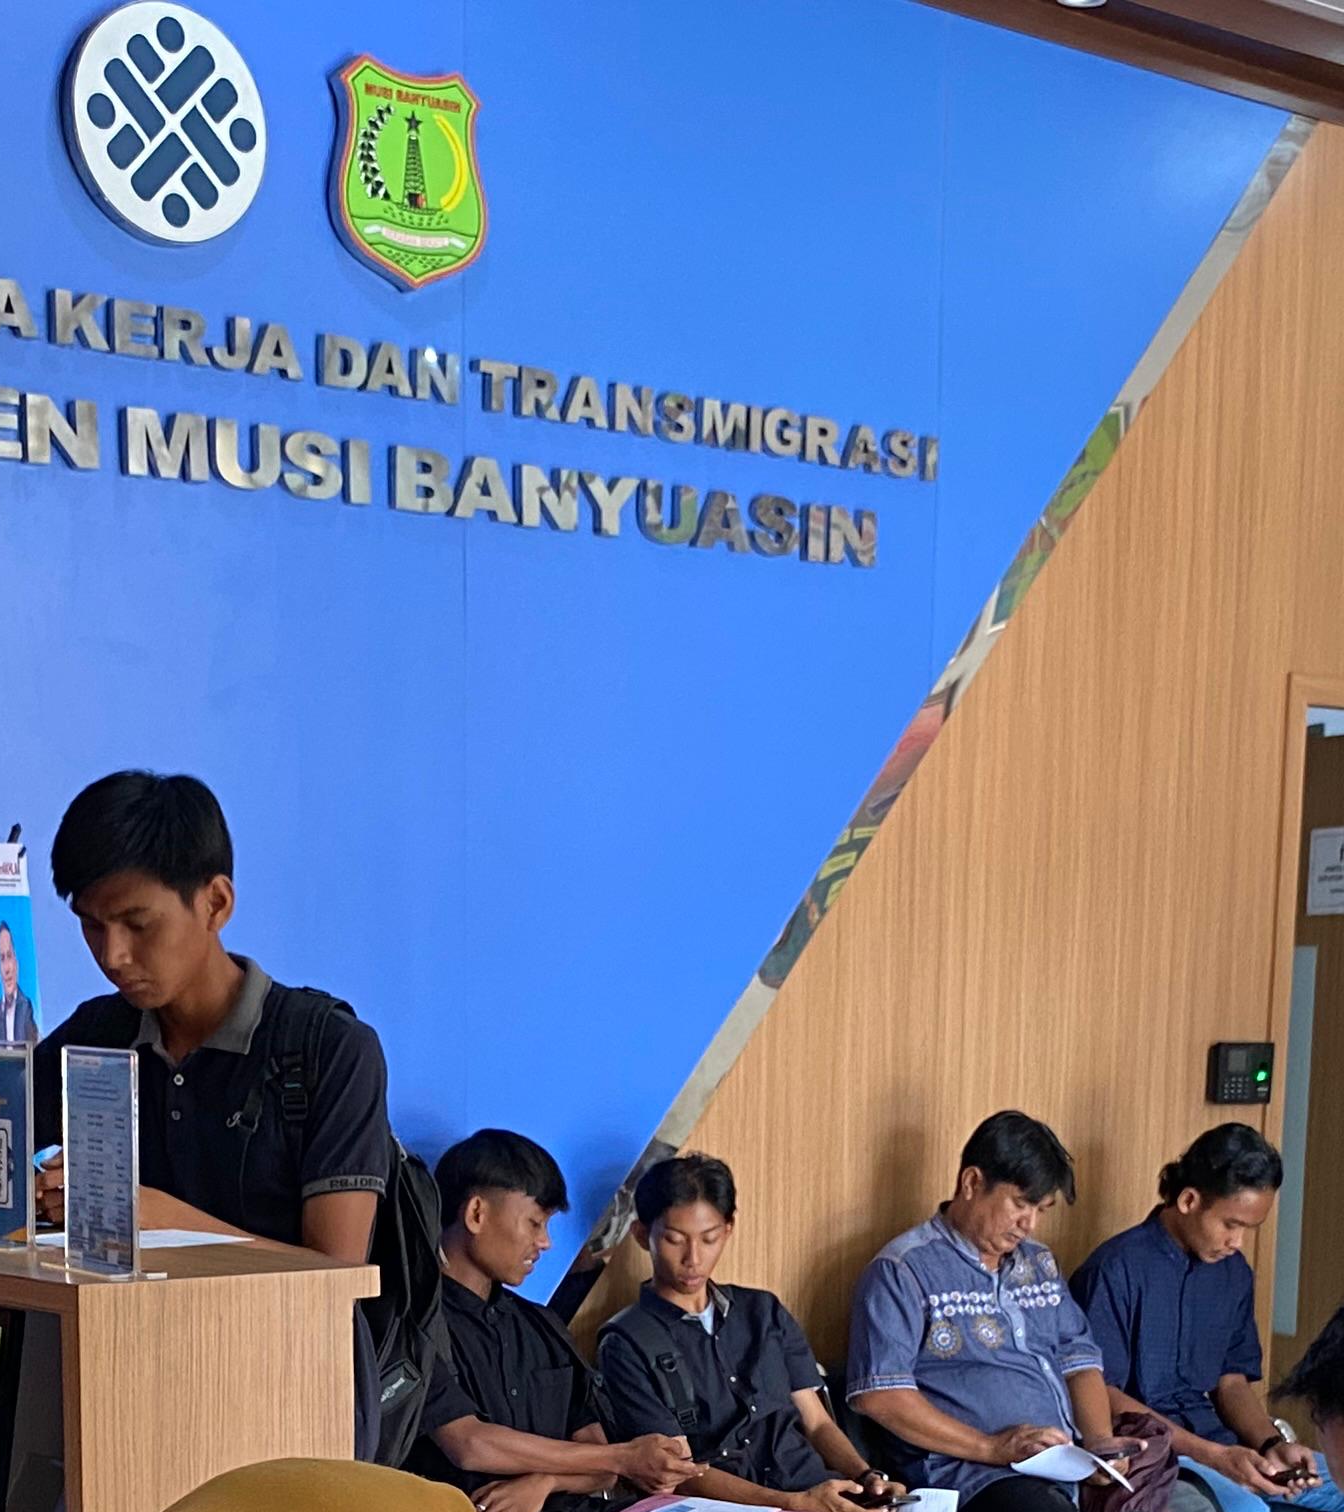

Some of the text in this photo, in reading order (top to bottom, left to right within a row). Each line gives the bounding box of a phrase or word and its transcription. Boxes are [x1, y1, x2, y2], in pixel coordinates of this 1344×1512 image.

[51, 287, 303, 382] KERJA
[317, 334, 458, 406] DAN
[471, 358, 939, 482] TRANSMIGRASI
[120, 407, 372, 507] MUSI
[390, 444, 878, 568] BANYUASIN
